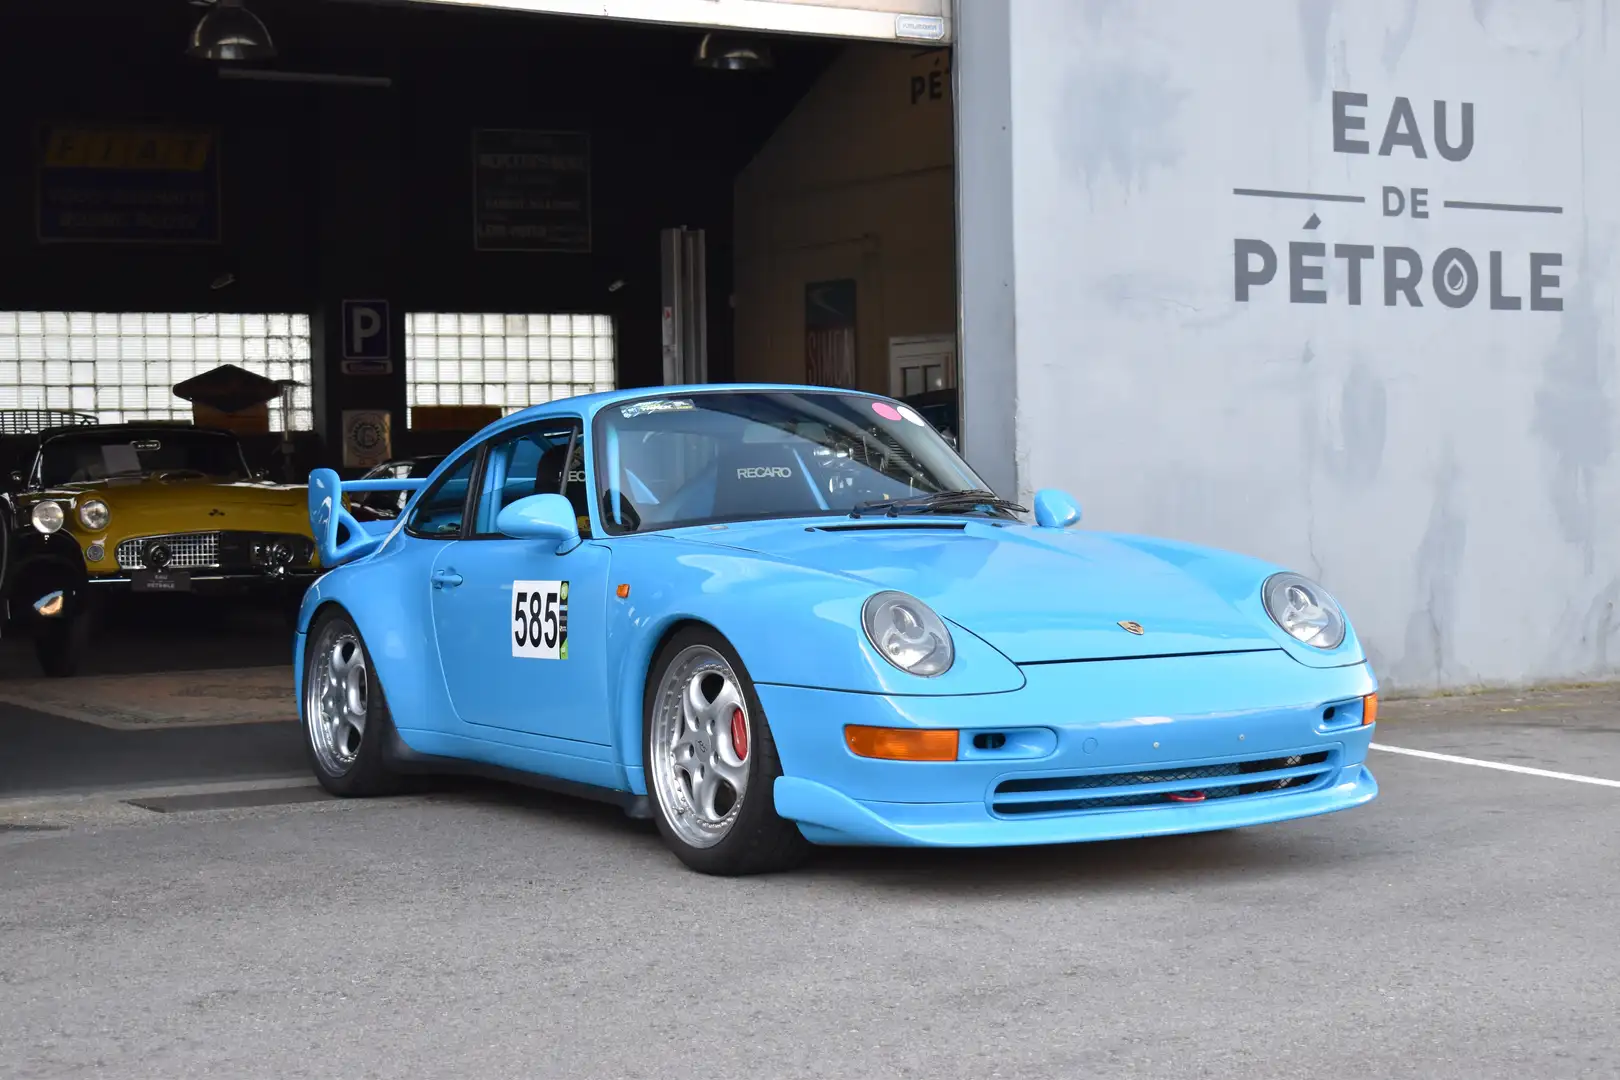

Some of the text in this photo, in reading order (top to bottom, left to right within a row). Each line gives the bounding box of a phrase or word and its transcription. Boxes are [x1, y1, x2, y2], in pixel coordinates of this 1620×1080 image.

[1332, 91, 1474, 162] EAU
[1382, 186, 1429, 218] DE
[1234, 213, 1563, 311] PÉTROLE
[353, 307, 381, 352] P
[737, 467, 792, 479] RECARO
[515, 592, 558, 648] 585
